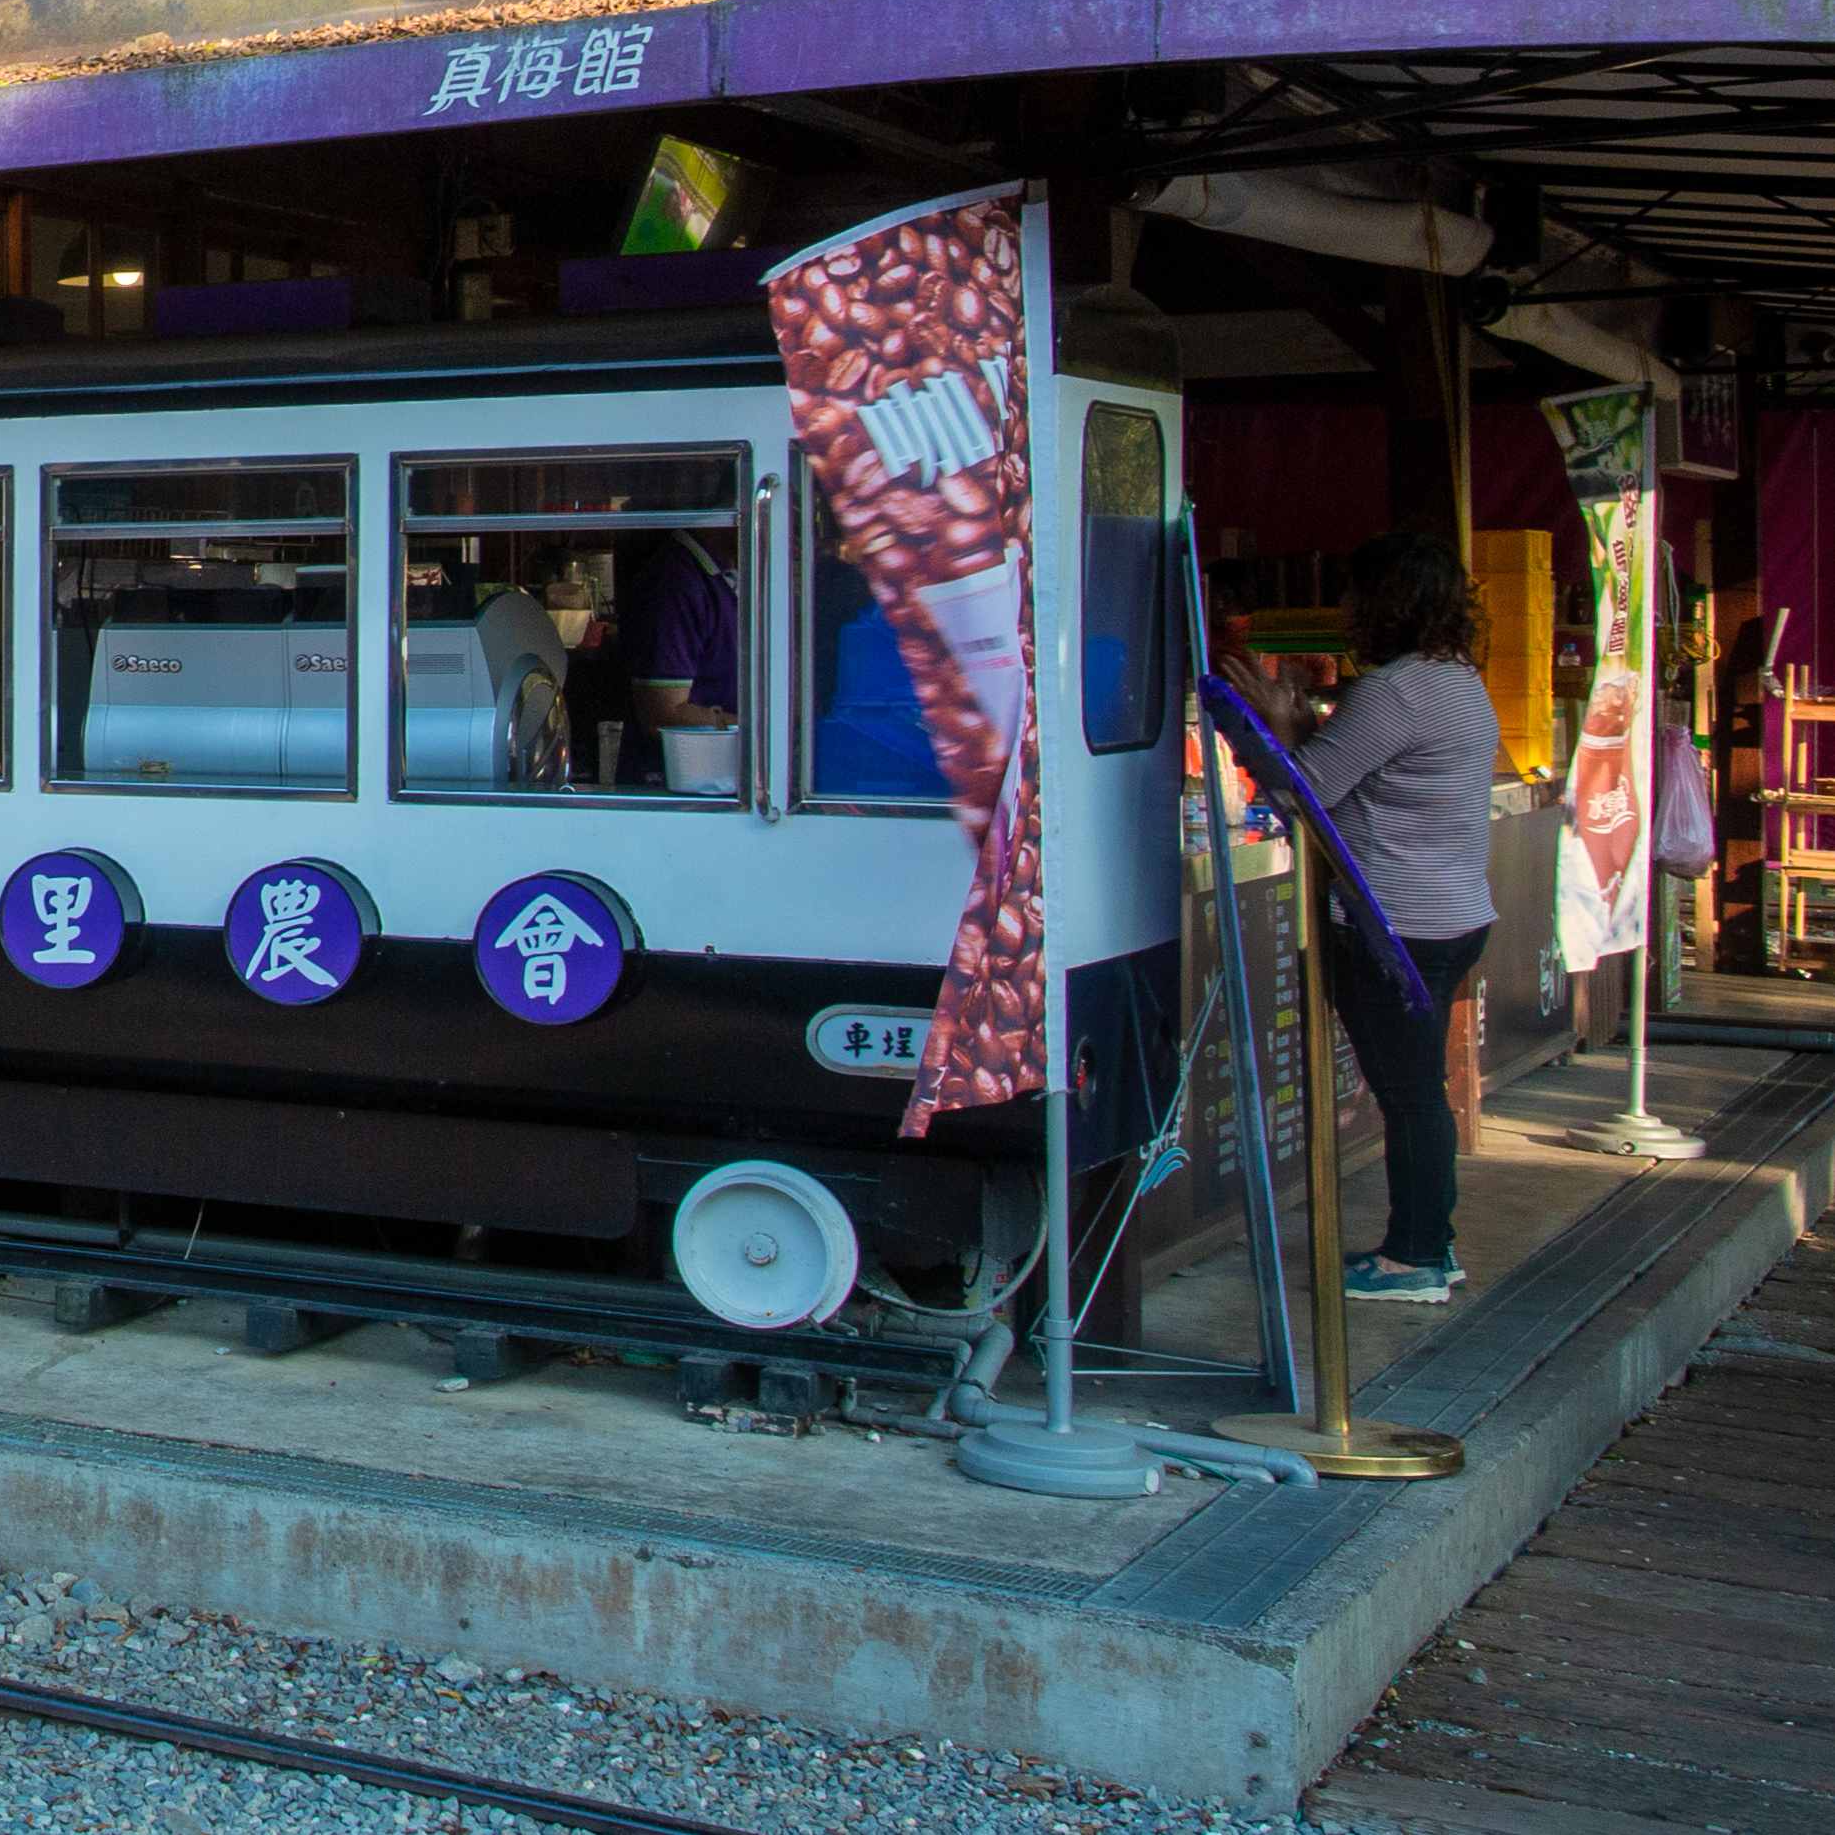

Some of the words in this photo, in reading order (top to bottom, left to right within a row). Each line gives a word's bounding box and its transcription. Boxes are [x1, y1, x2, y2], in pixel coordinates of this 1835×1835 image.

[422, 23, 654, 116] 真梅館
[126, 654, 182, 673] Saeco
[310, 654, 347, 672] Sae
[843, 1022, 915, 1059] 車埕
